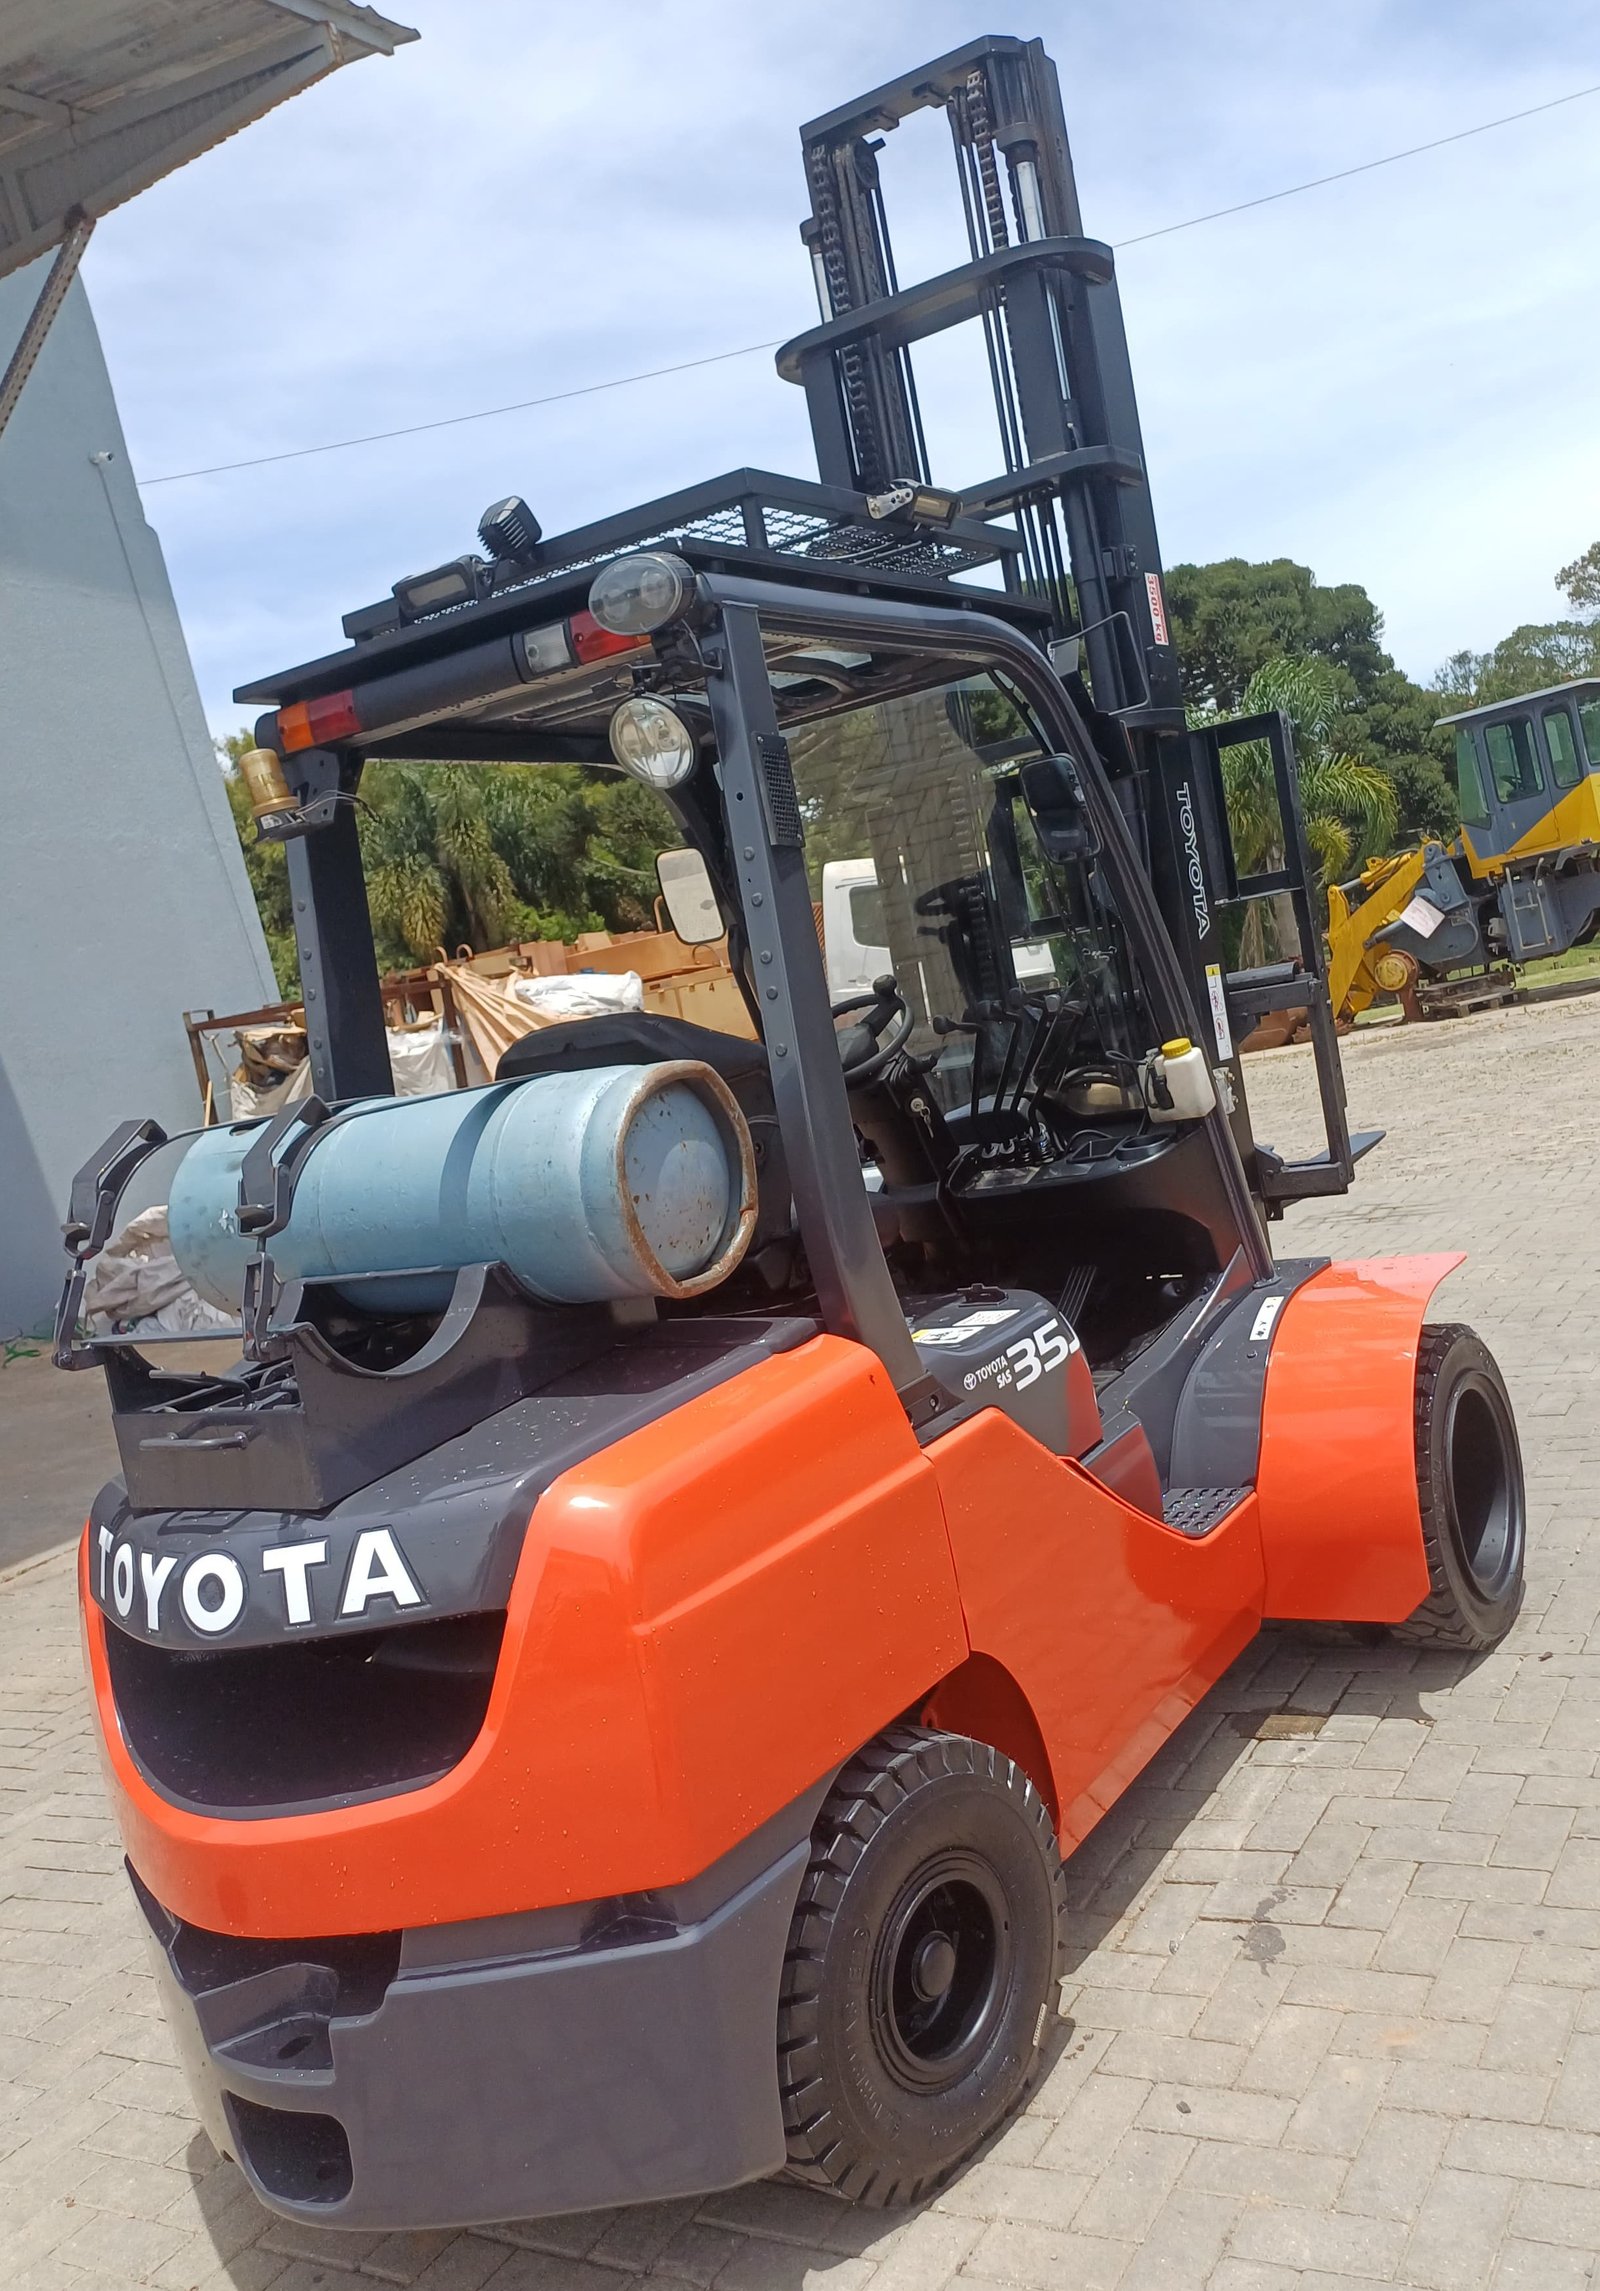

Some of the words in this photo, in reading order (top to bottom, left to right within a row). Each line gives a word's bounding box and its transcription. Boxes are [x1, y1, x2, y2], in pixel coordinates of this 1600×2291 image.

[1147, 575, 1159, 618] 3500
[1176, 782, 1210, 940] TOYOTA
[975, 1355, 1008, 1384] TOYOTA
[996, 1368, 1013, 1389] SAS
[97, 1524, 422, 1635] TOYOTA
